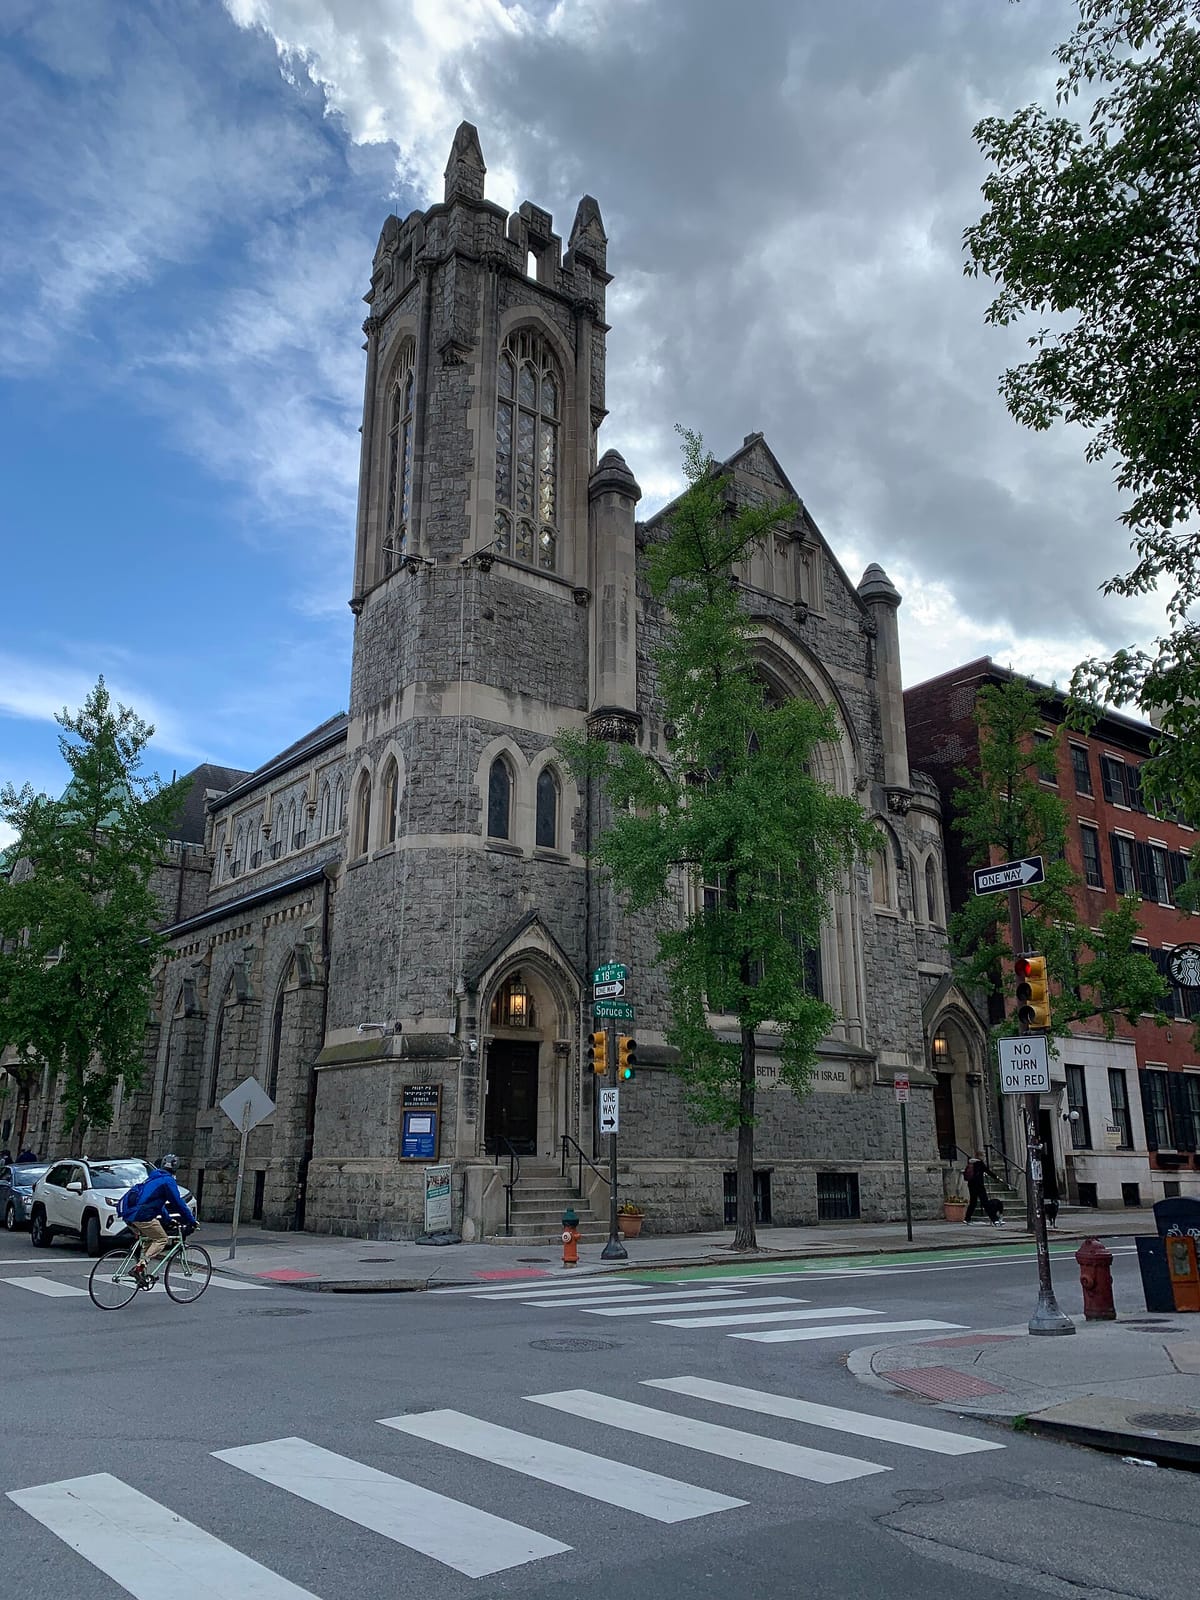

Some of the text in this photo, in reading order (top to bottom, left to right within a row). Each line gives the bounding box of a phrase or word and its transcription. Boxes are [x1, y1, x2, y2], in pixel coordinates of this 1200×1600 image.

[982, 868, 1021, 886] ONE WAY
[596, 1005, 633, 1018] Spruce St
[1014, 1044, 1031, 1055] NO
[1010, 1059, 1037, 1070] TURN
[756, 1065, 776, 1077] BETH
[821, 1070, 847, 1082] ISRAEL
[1006, 1074, 1045, 1086] ON RED
[603, 1092, 616, 1103] ONE
[603, 1104, 616, 1115] WAY
